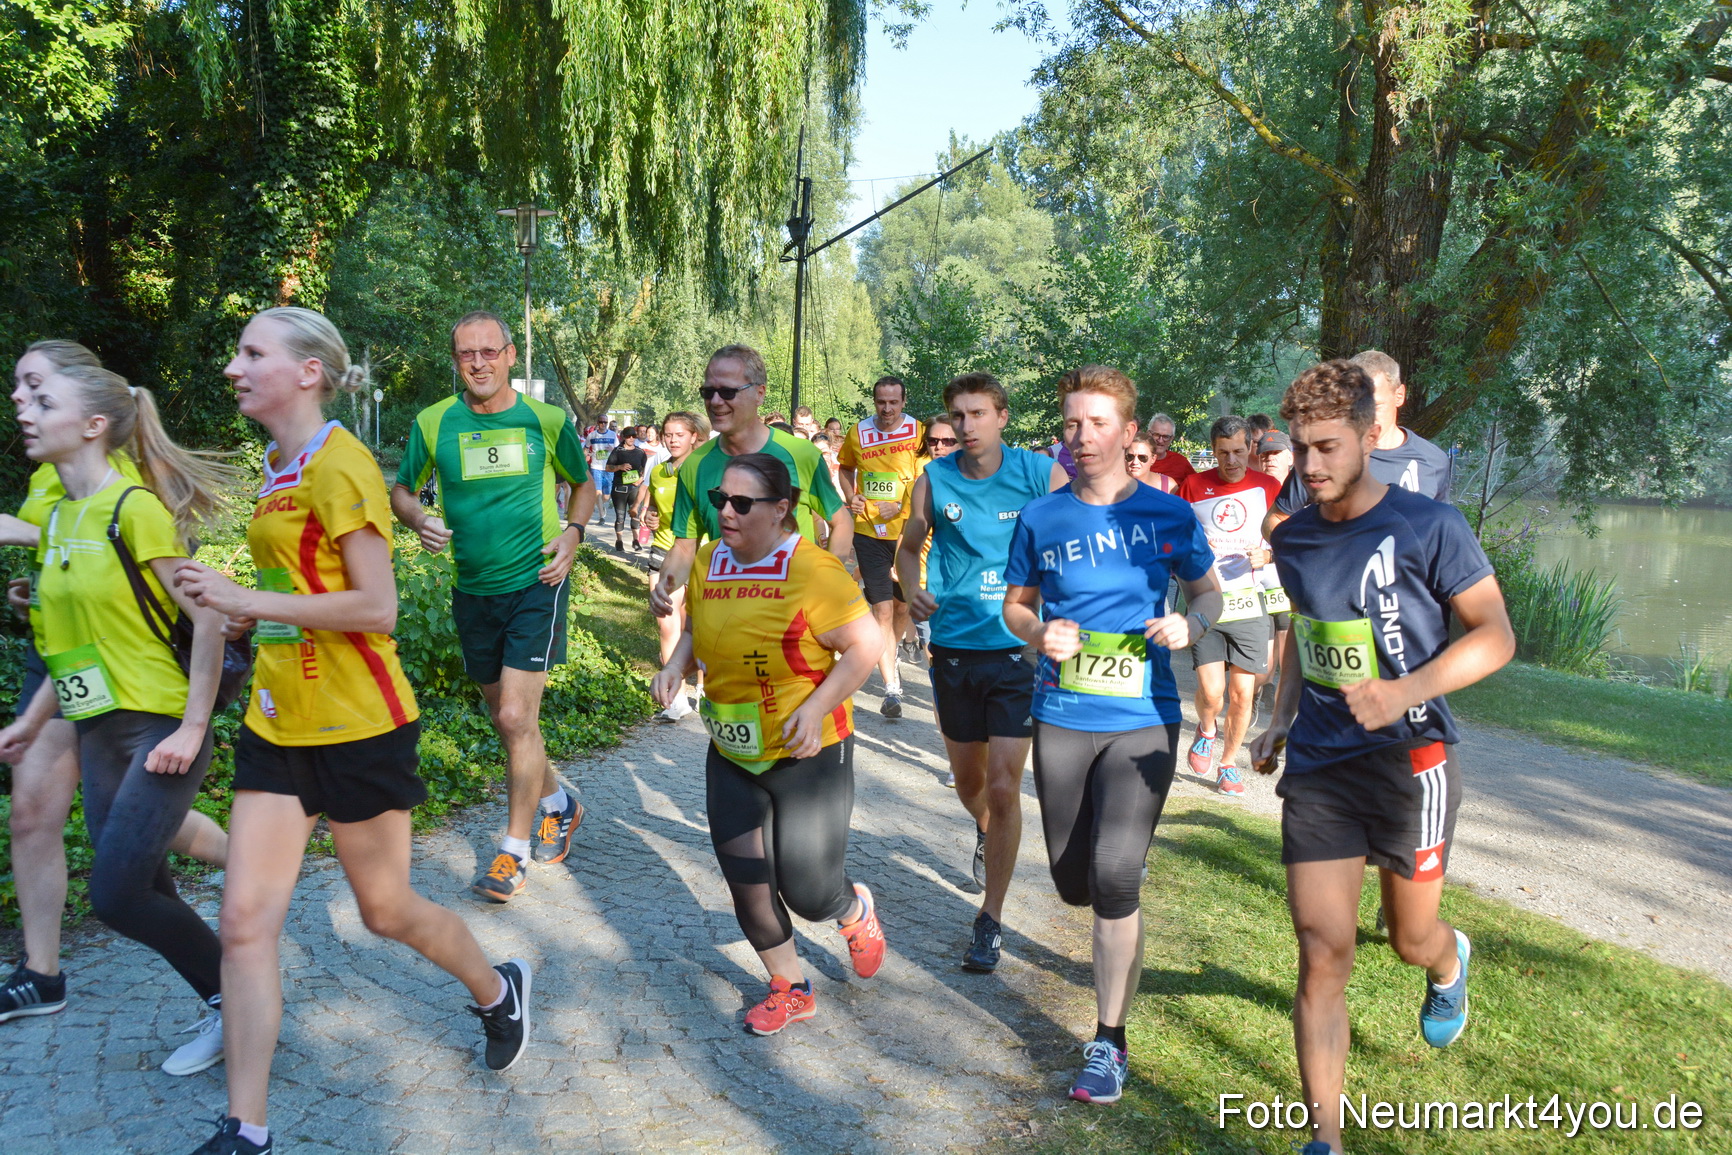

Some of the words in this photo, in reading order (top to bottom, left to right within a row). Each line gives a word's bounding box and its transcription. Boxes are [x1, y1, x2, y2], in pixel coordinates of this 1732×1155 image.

[488, 447, 499, 463] 8
[862, 449, 886, 460] MAX
[890, 443, 917, 454] BÖGL
[866, 481, 893, 492] 1266
[981, 571, 1002, 584] 18.
[703, 587, 732, 600] MAX
[736, 584, 785, 600] BÖGL
[1304, 640, 1362, 670] 1606
[1072, 652, 1133, 679] 1726
[706, 717, 751, 744] 1239
